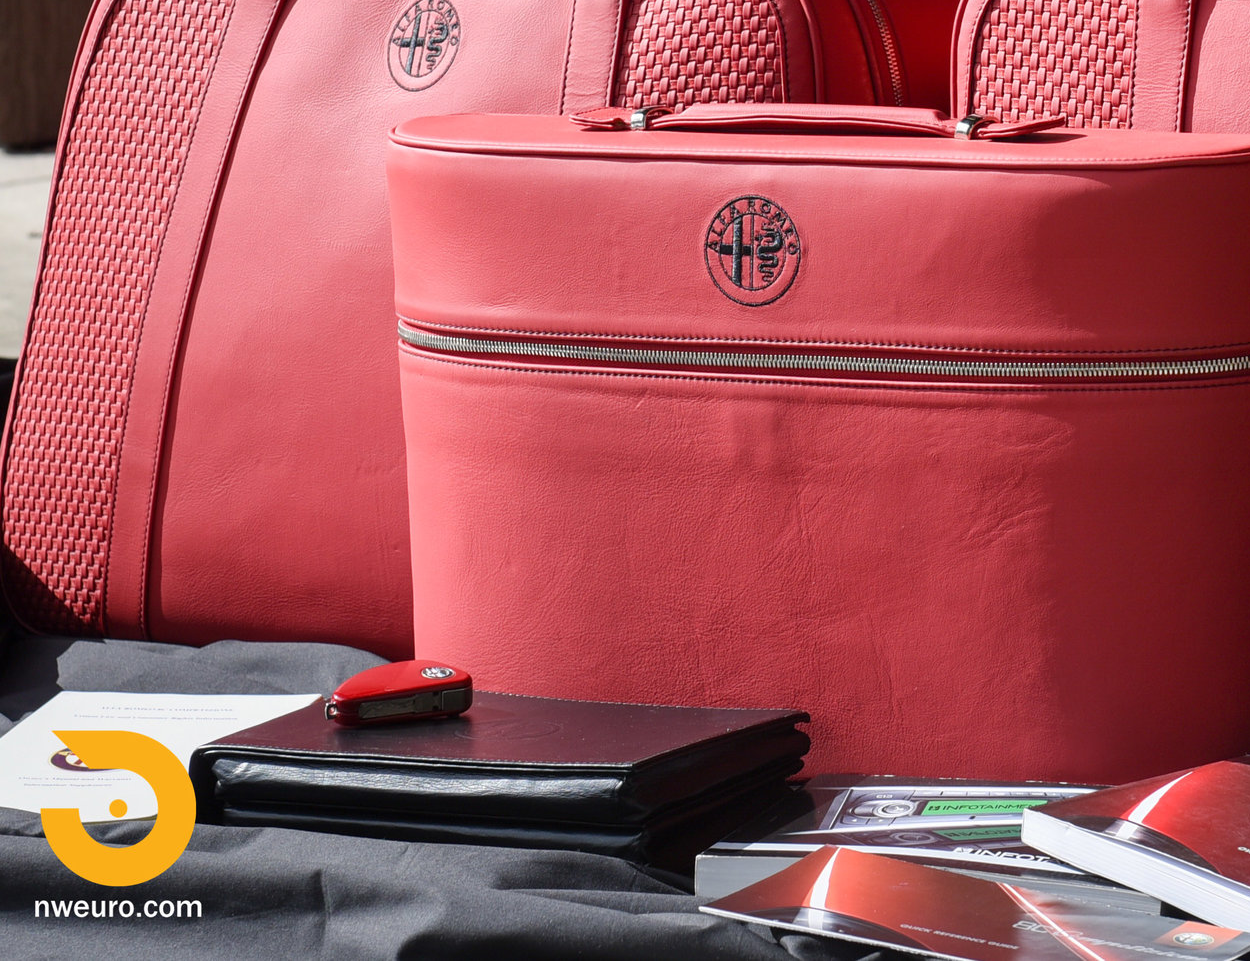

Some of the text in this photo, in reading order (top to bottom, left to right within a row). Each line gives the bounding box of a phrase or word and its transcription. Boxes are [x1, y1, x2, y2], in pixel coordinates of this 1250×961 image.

[391, 4, 422, 46] ALFA
[708, 198, 799, 256] ALFA ROMEO
[942, 801, 1038, 812] INFOTAINME
